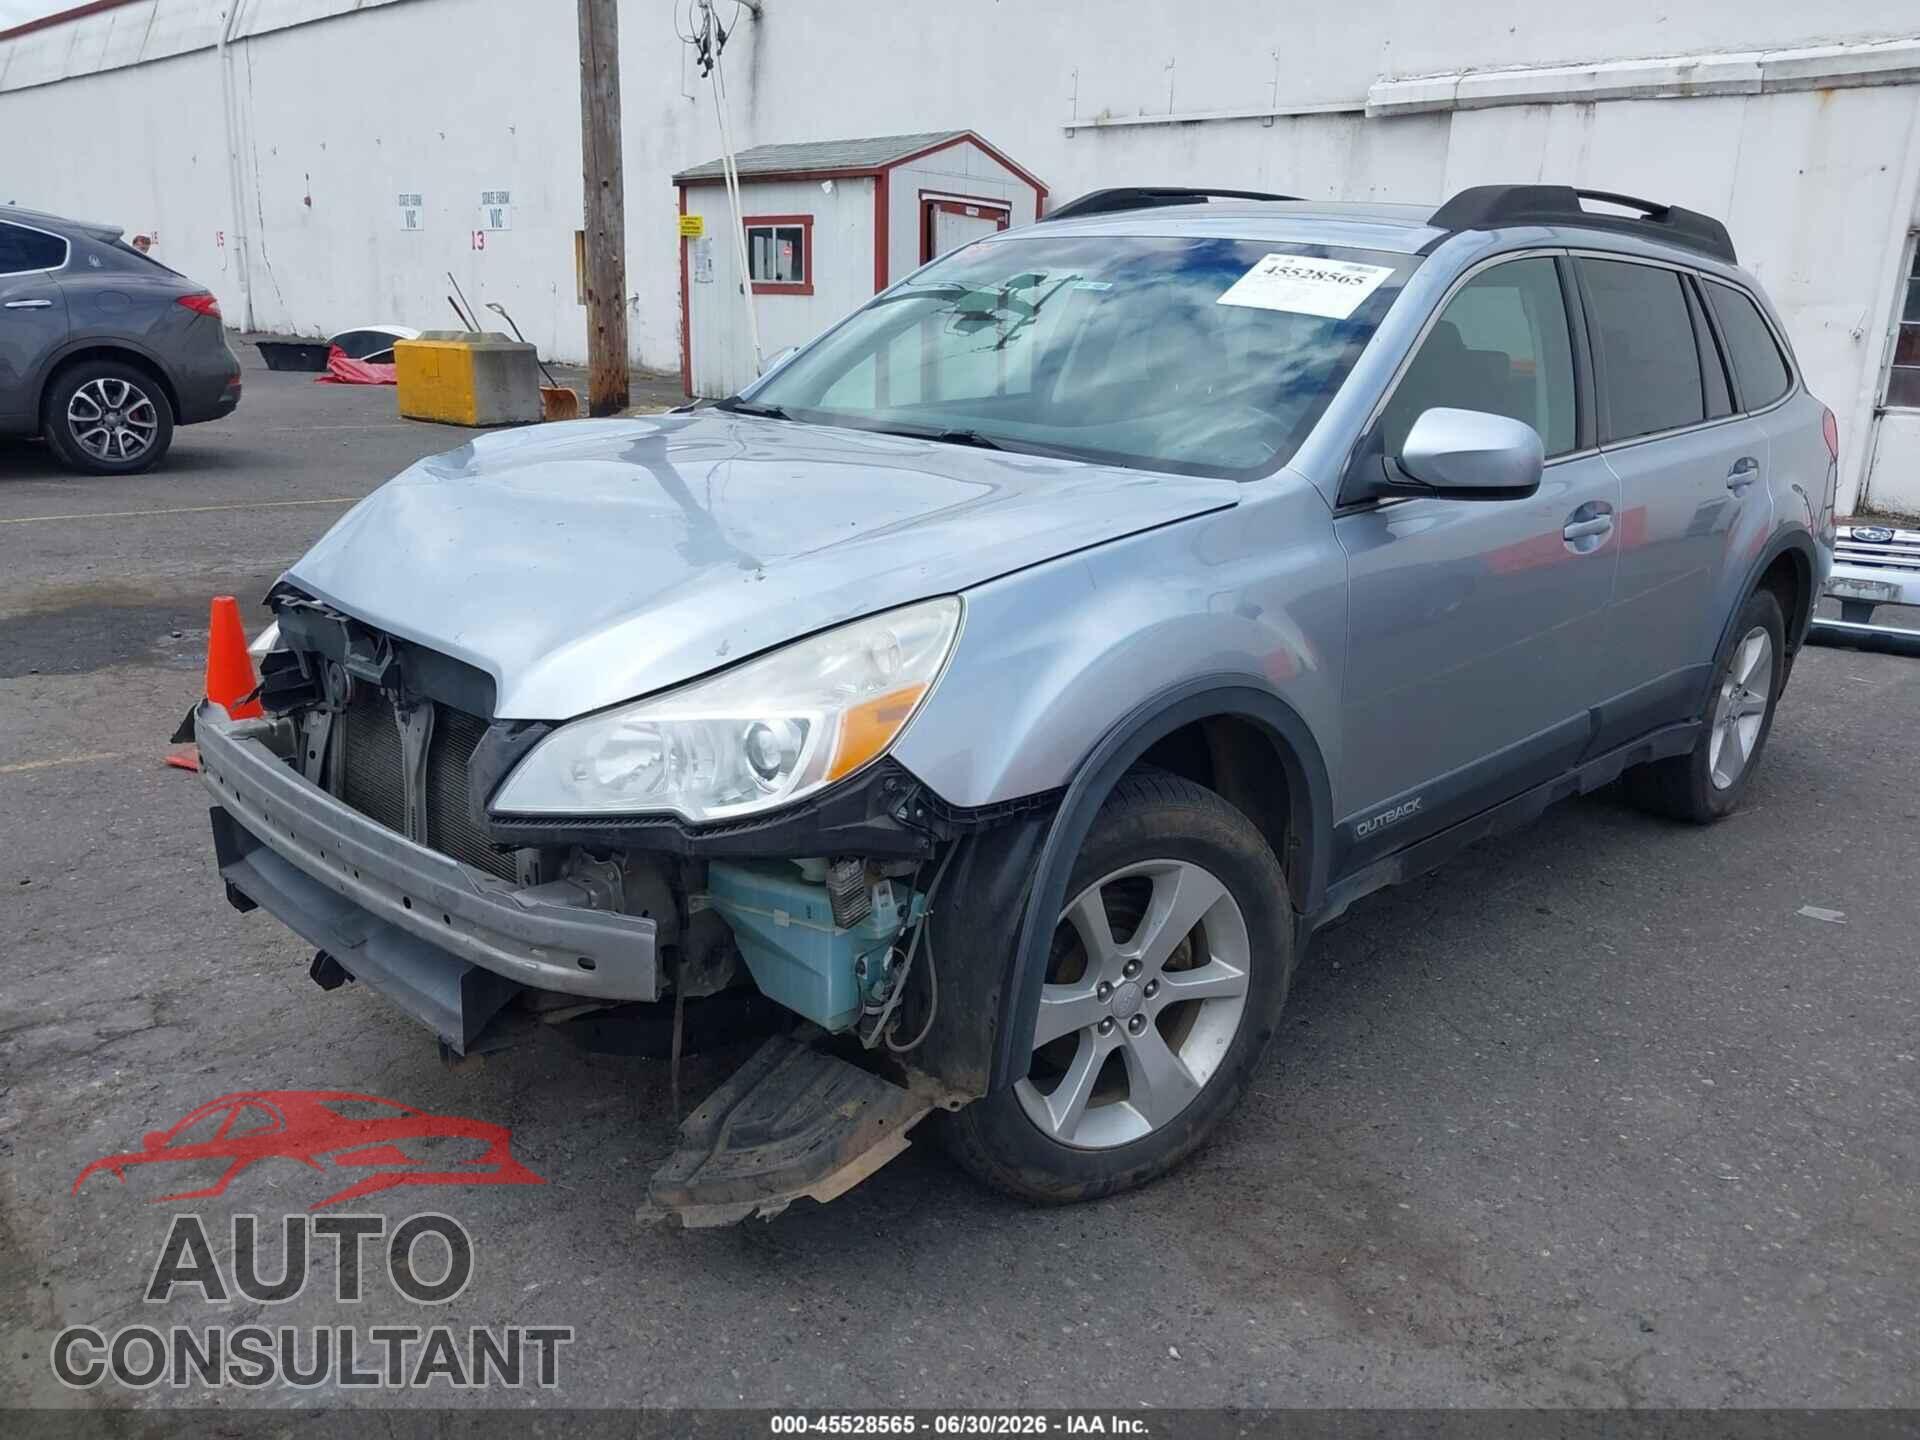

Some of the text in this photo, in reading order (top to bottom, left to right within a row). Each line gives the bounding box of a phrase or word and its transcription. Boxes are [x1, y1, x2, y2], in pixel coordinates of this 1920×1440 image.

[471, 230, 485, 250] 13
[1263, 265, 1368, 286] 45528565
[1357, 797, 1421, 836] OUTBACK
